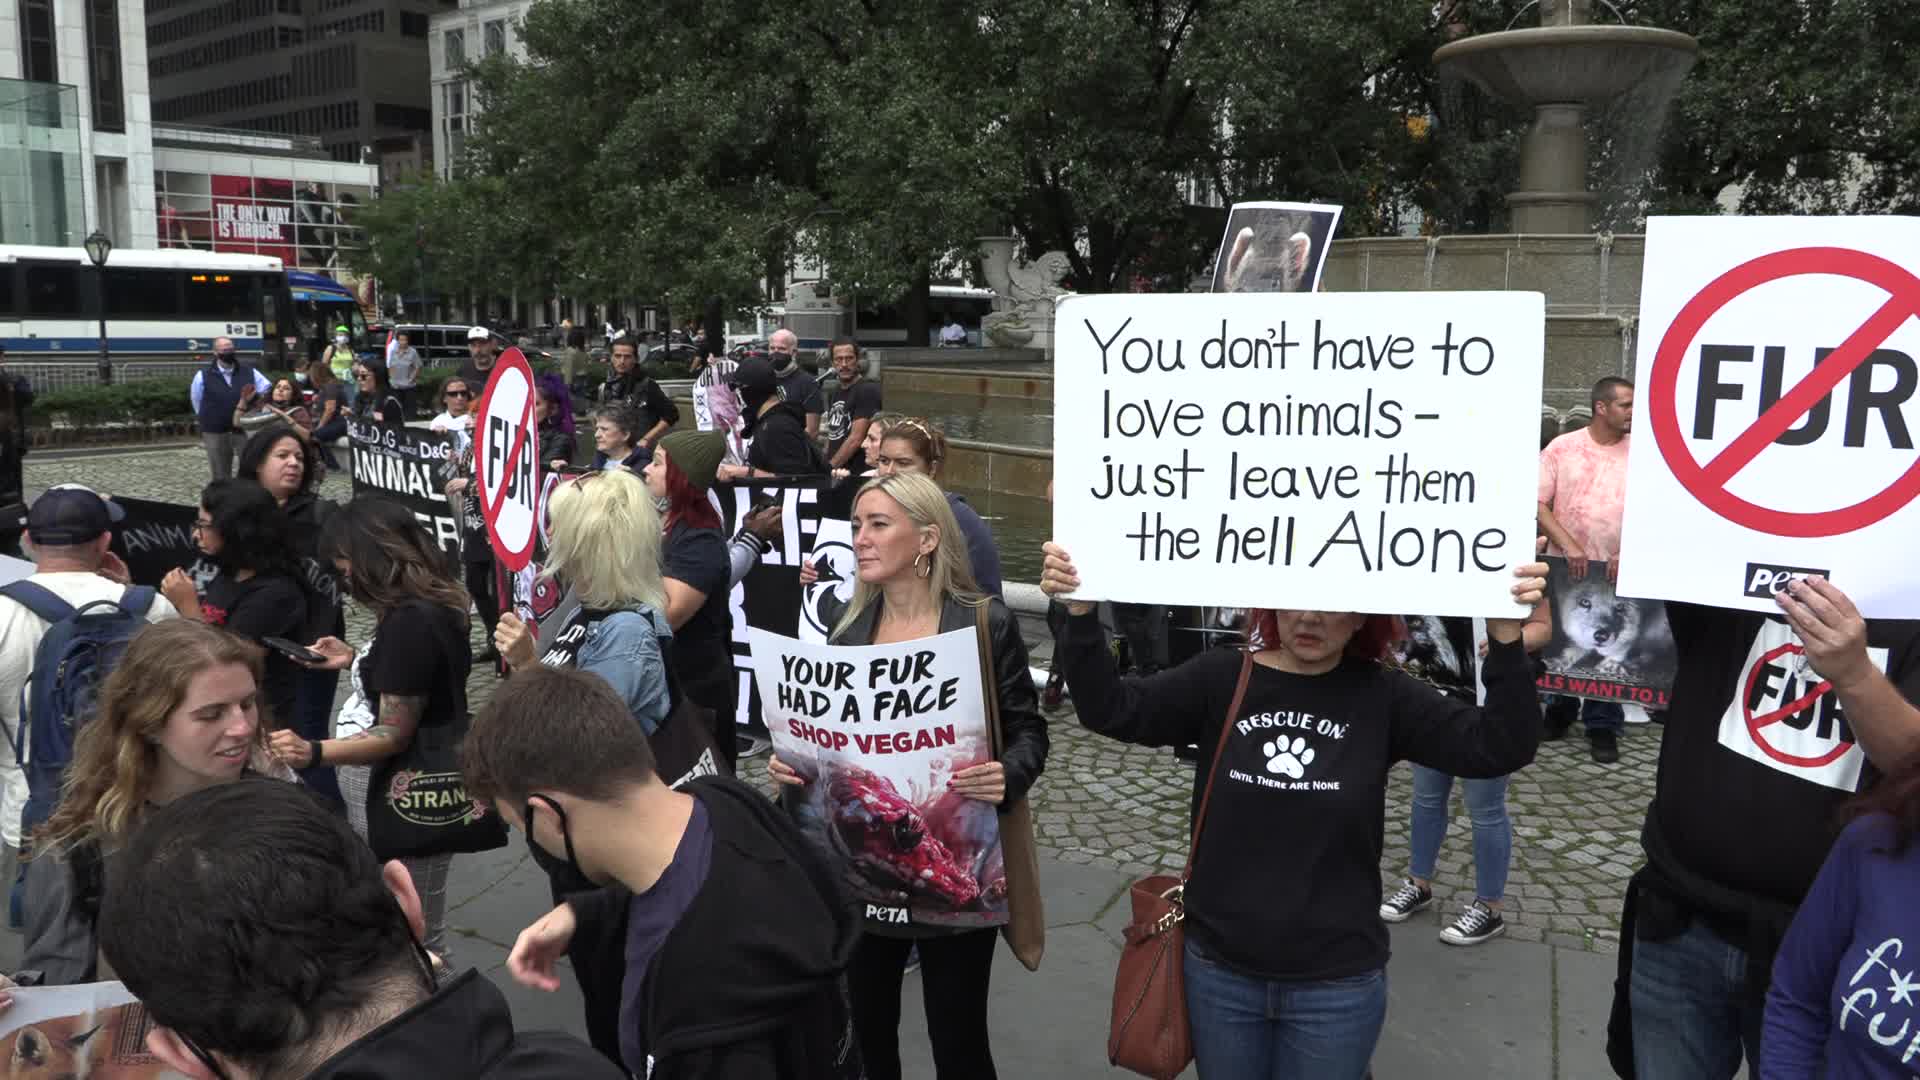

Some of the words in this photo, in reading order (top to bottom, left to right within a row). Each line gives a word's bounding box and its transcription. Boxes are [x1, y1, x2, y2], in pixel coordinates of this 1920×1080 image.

[216, 203, 235, 220] THE
[237, 205, 264, 222] ONLY
[266, 207, 290, 224] WAY
[219, 221, 230, 238] IS
[233, 222, 285, 240] THROUGH.
[1084, 316, 1186, 374] You
[1200, 318, 1300, 369] don't
[1313, 319, 1415, 371] have
[1431, 322, 1494, 376] to
[1103, 389, 1205, 439] love
[1693, 343, 1918, 450] FUR
[487, 415, 533, 512] FUR
[1090, 448, 1205, 500] just
[1229, 451, 1361, 501] leave
[1374, 452, 1476, 504] them
[1125, 511, 1201, 561] the
[1215, 513, 1295, 566] hell
[1308, 510, 1508, 573] Alone
[781, 653, 856, 691] YOUR
[868, 650, 937, 689] FUR
[1567, 678, 1625, 698] WANT
[1630, 687, 1653, 704] TO
[777, 682, 831, 719] HAD
[839, 694, 861, 724] A
[873, 677, 961, 722] FACE
[787, 718, 849, 752] SHOP
[852, 724, 956, 755] VEGAN
[1235, 711, 1315, 737] RESCUE
[399, 788, 466, 809] STRAN
[1229, 769, 1254, 784] UNTIL
[1257, 775, 1287, 790] THERE
[1312, 780, 1341, 791] NONE
